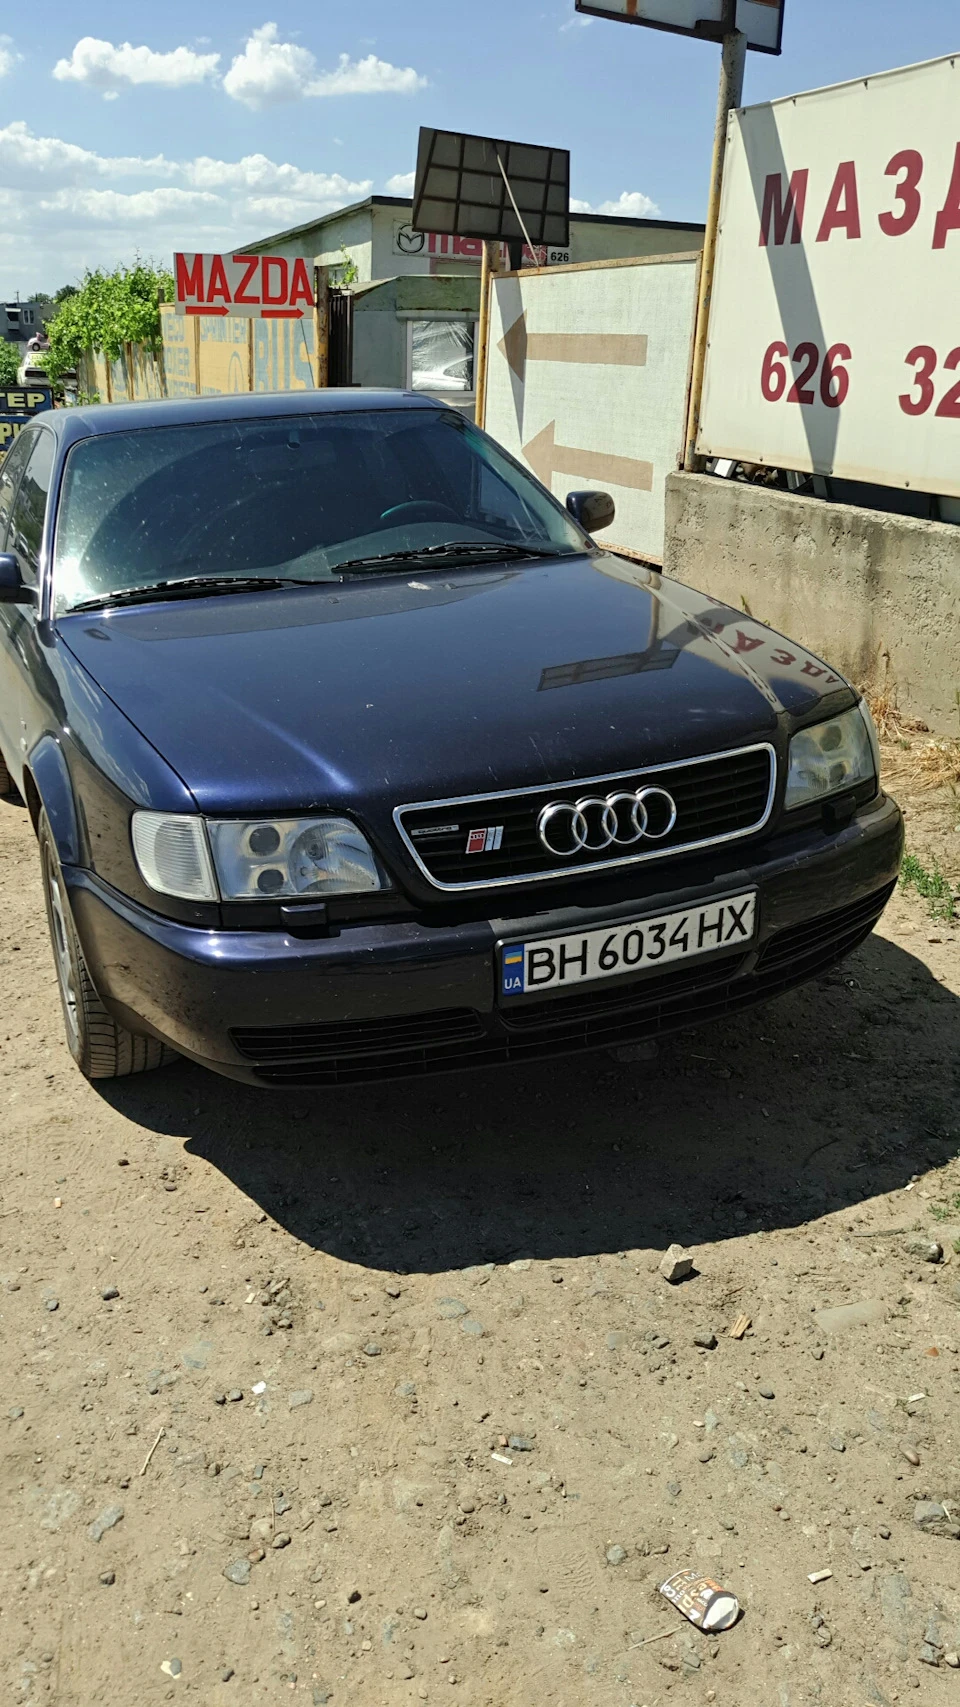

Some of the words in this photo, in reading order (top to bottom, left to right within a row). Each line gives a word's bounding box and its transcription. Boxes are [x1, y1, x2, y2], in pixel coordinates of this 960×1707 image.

[175, 252, 314, 307] MAZDA
[551, 252, 569, 261] 626
[760, 341, 852, 408] 626
[898, 344, 960, 419] 32
[527, 939, 588, 986] BH
[598, 917, 689, 971] 6034
[697, 900, 751, 948] HX
[504, 976, 522, 990] UA
